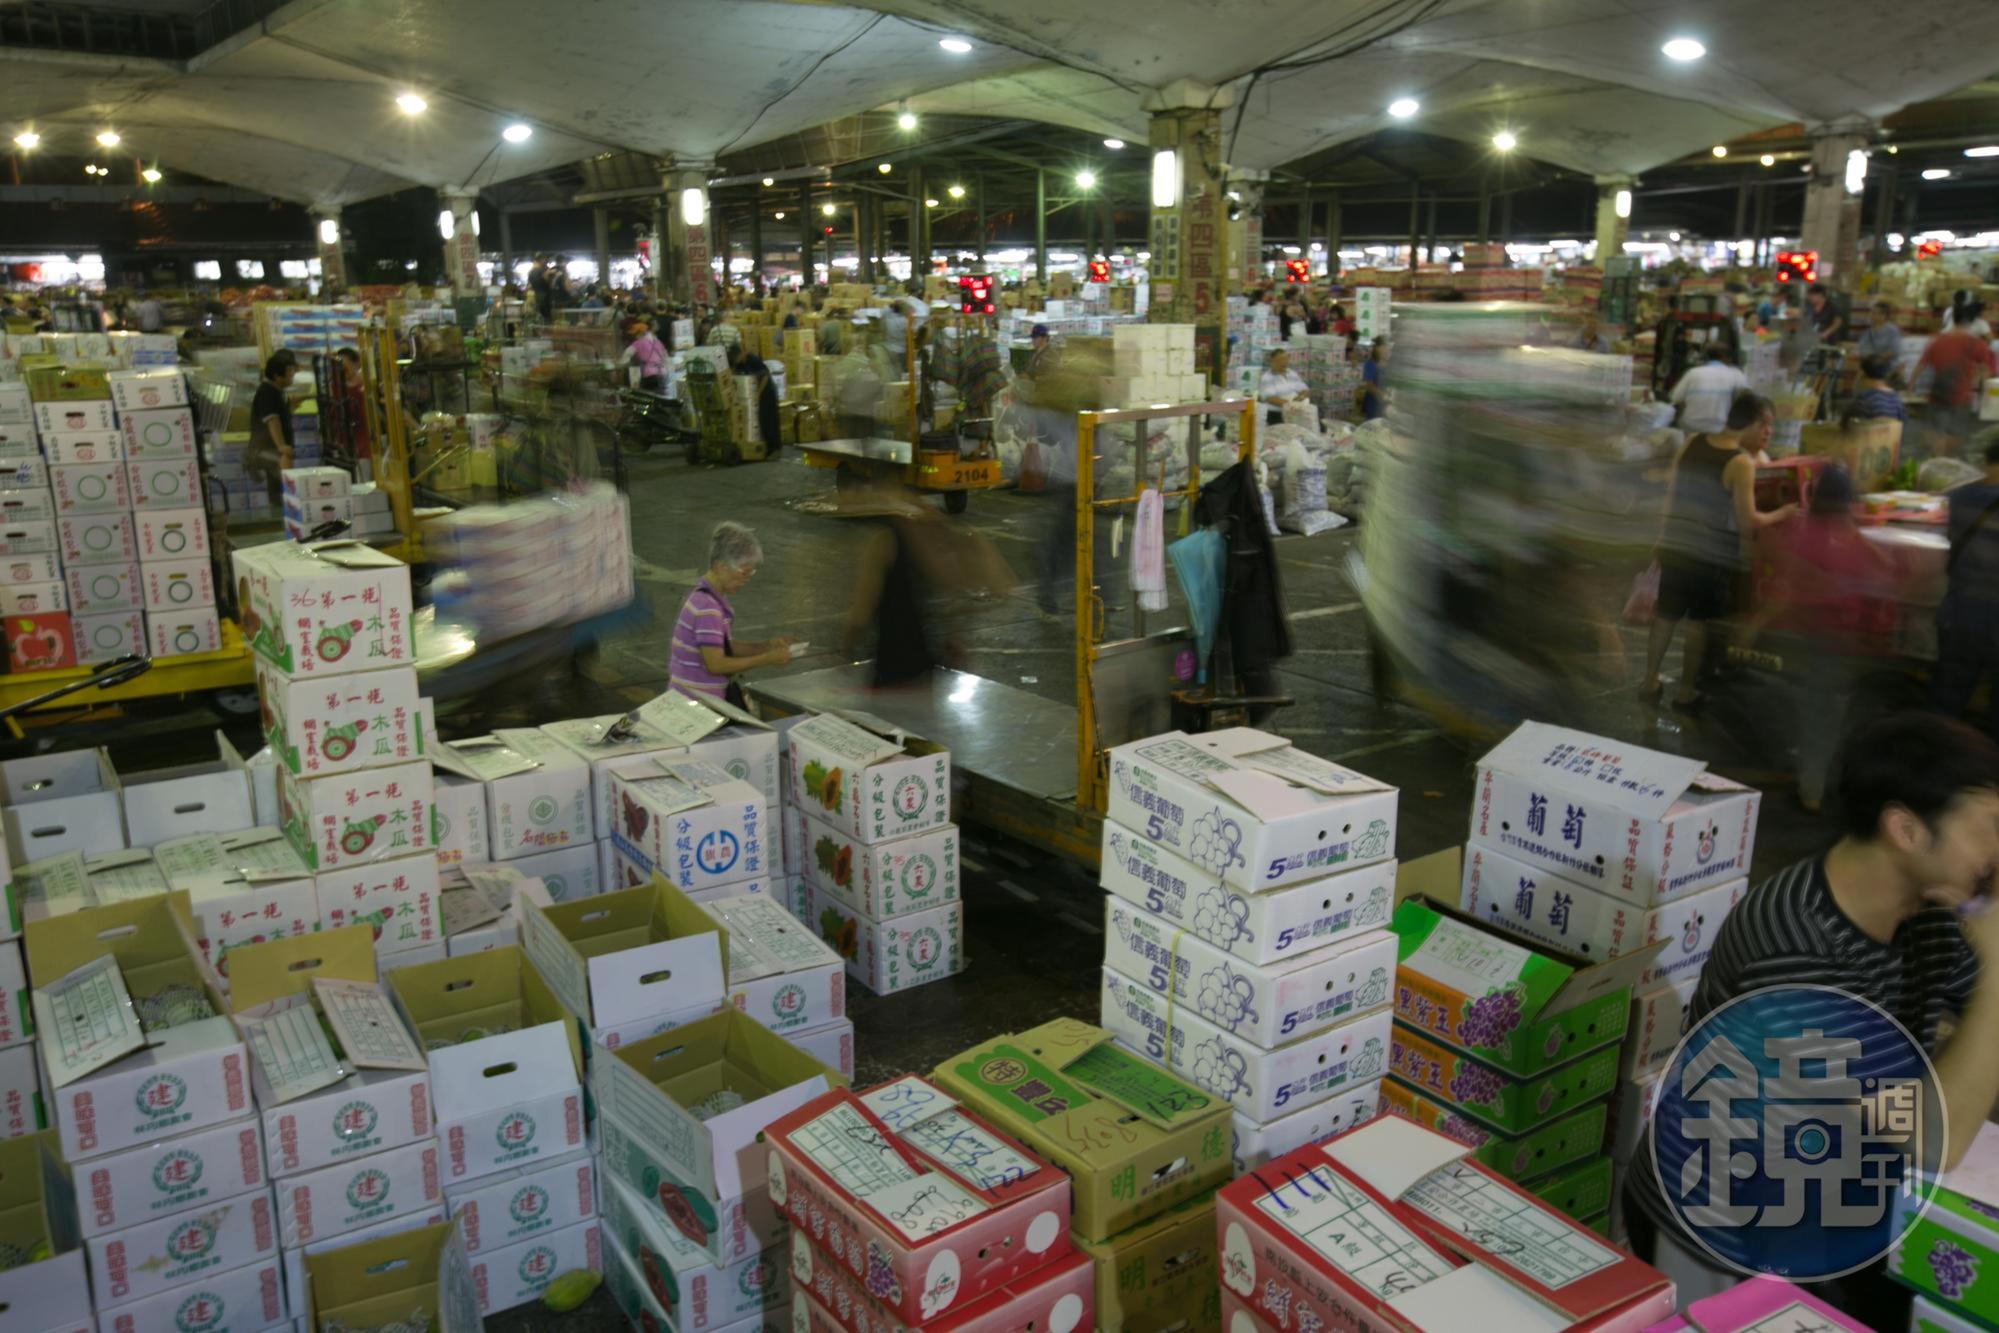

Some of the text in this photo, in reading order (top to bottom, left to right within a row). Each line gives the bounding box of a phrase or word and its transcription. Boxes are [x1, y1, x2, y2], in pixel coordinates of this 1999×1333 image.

[955, 467, 989, 484] 2104
[366, 614, 385, 658] 木瓜
[371, 714, 392, 756] 木瓜
[389, 808, 409, 848] 木瓜
[872, 773, 886, 839] 分級包裝
[1128, 783, 1185, 827] 信義葡萄
[1527, 791, 1587, 850] 葡萄
[676, 818, 695, 888] 分級包裝
[743, 804, 760, 872] 品質保證
[882, 852, 896, 916] 分級包裝
[1127, 855, 1187, 901] 信義葡萄
[396, 902, 418, 940] 木瓜
[1515, 876, 1574, 936] 葡萄
[887, 927, 900, 990] 分級包裝
[1399, 987, 1451, 1035] 黑紫王
[1391, 1042, 1445, 1089] 黑紫王
[1112, 1164, 1136, 1201] 明
